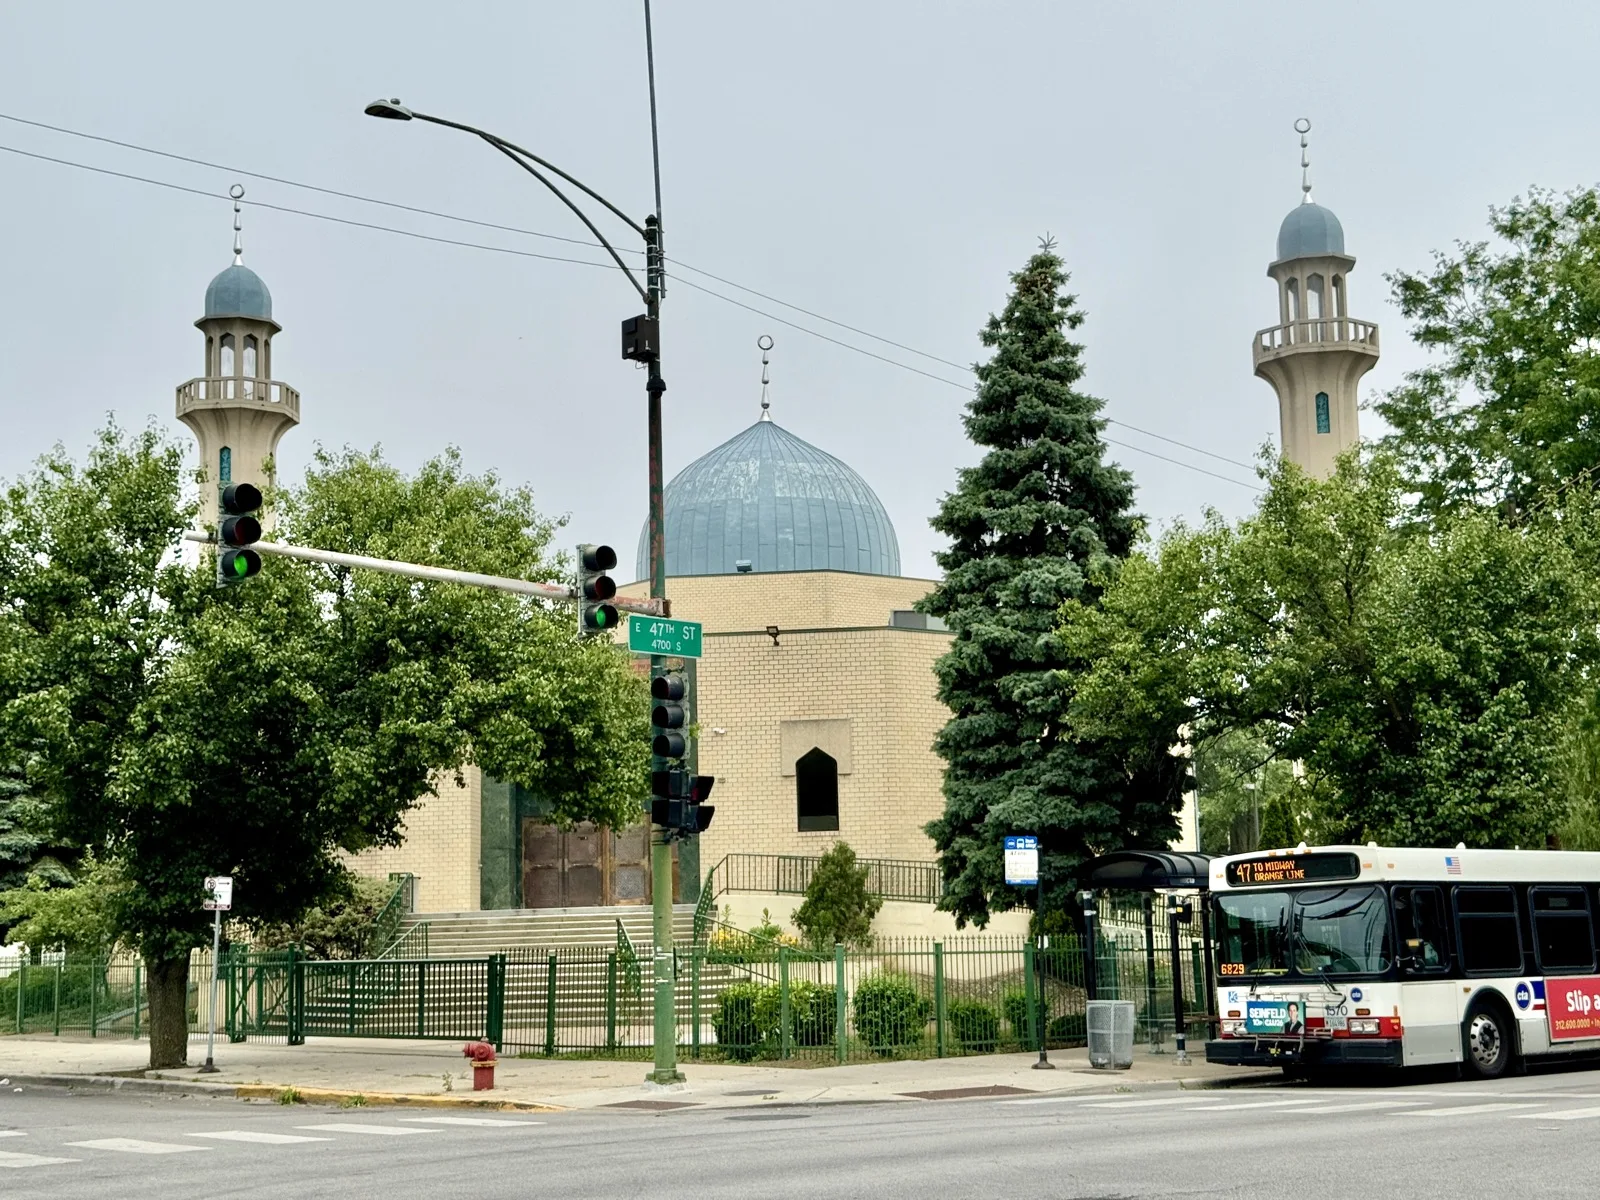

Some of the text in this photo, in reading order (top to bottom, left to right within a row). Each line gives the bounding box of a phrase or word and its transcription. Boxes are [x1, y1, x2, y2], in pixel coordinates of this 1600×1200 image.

[635, 622, 696, 640] E 47TH ST
[651, 639, 682, 652] 4700 S
[1236, 860, 1296, 883] 47 TO MIDWAY
[1254, 869, 1305, 882] ORANGE LINE
[1221, 963, 1245, 975] 6829
[1517, 990, 1529, 1001] cta
[1565, 989, 1591, 1016] Slip
[1249, 1007, 1287, 1019] SEINFELD
[1325, 1005, 1348, 1017] 1570
[1555, 1018, 1591, 1030] 312.600.0000
